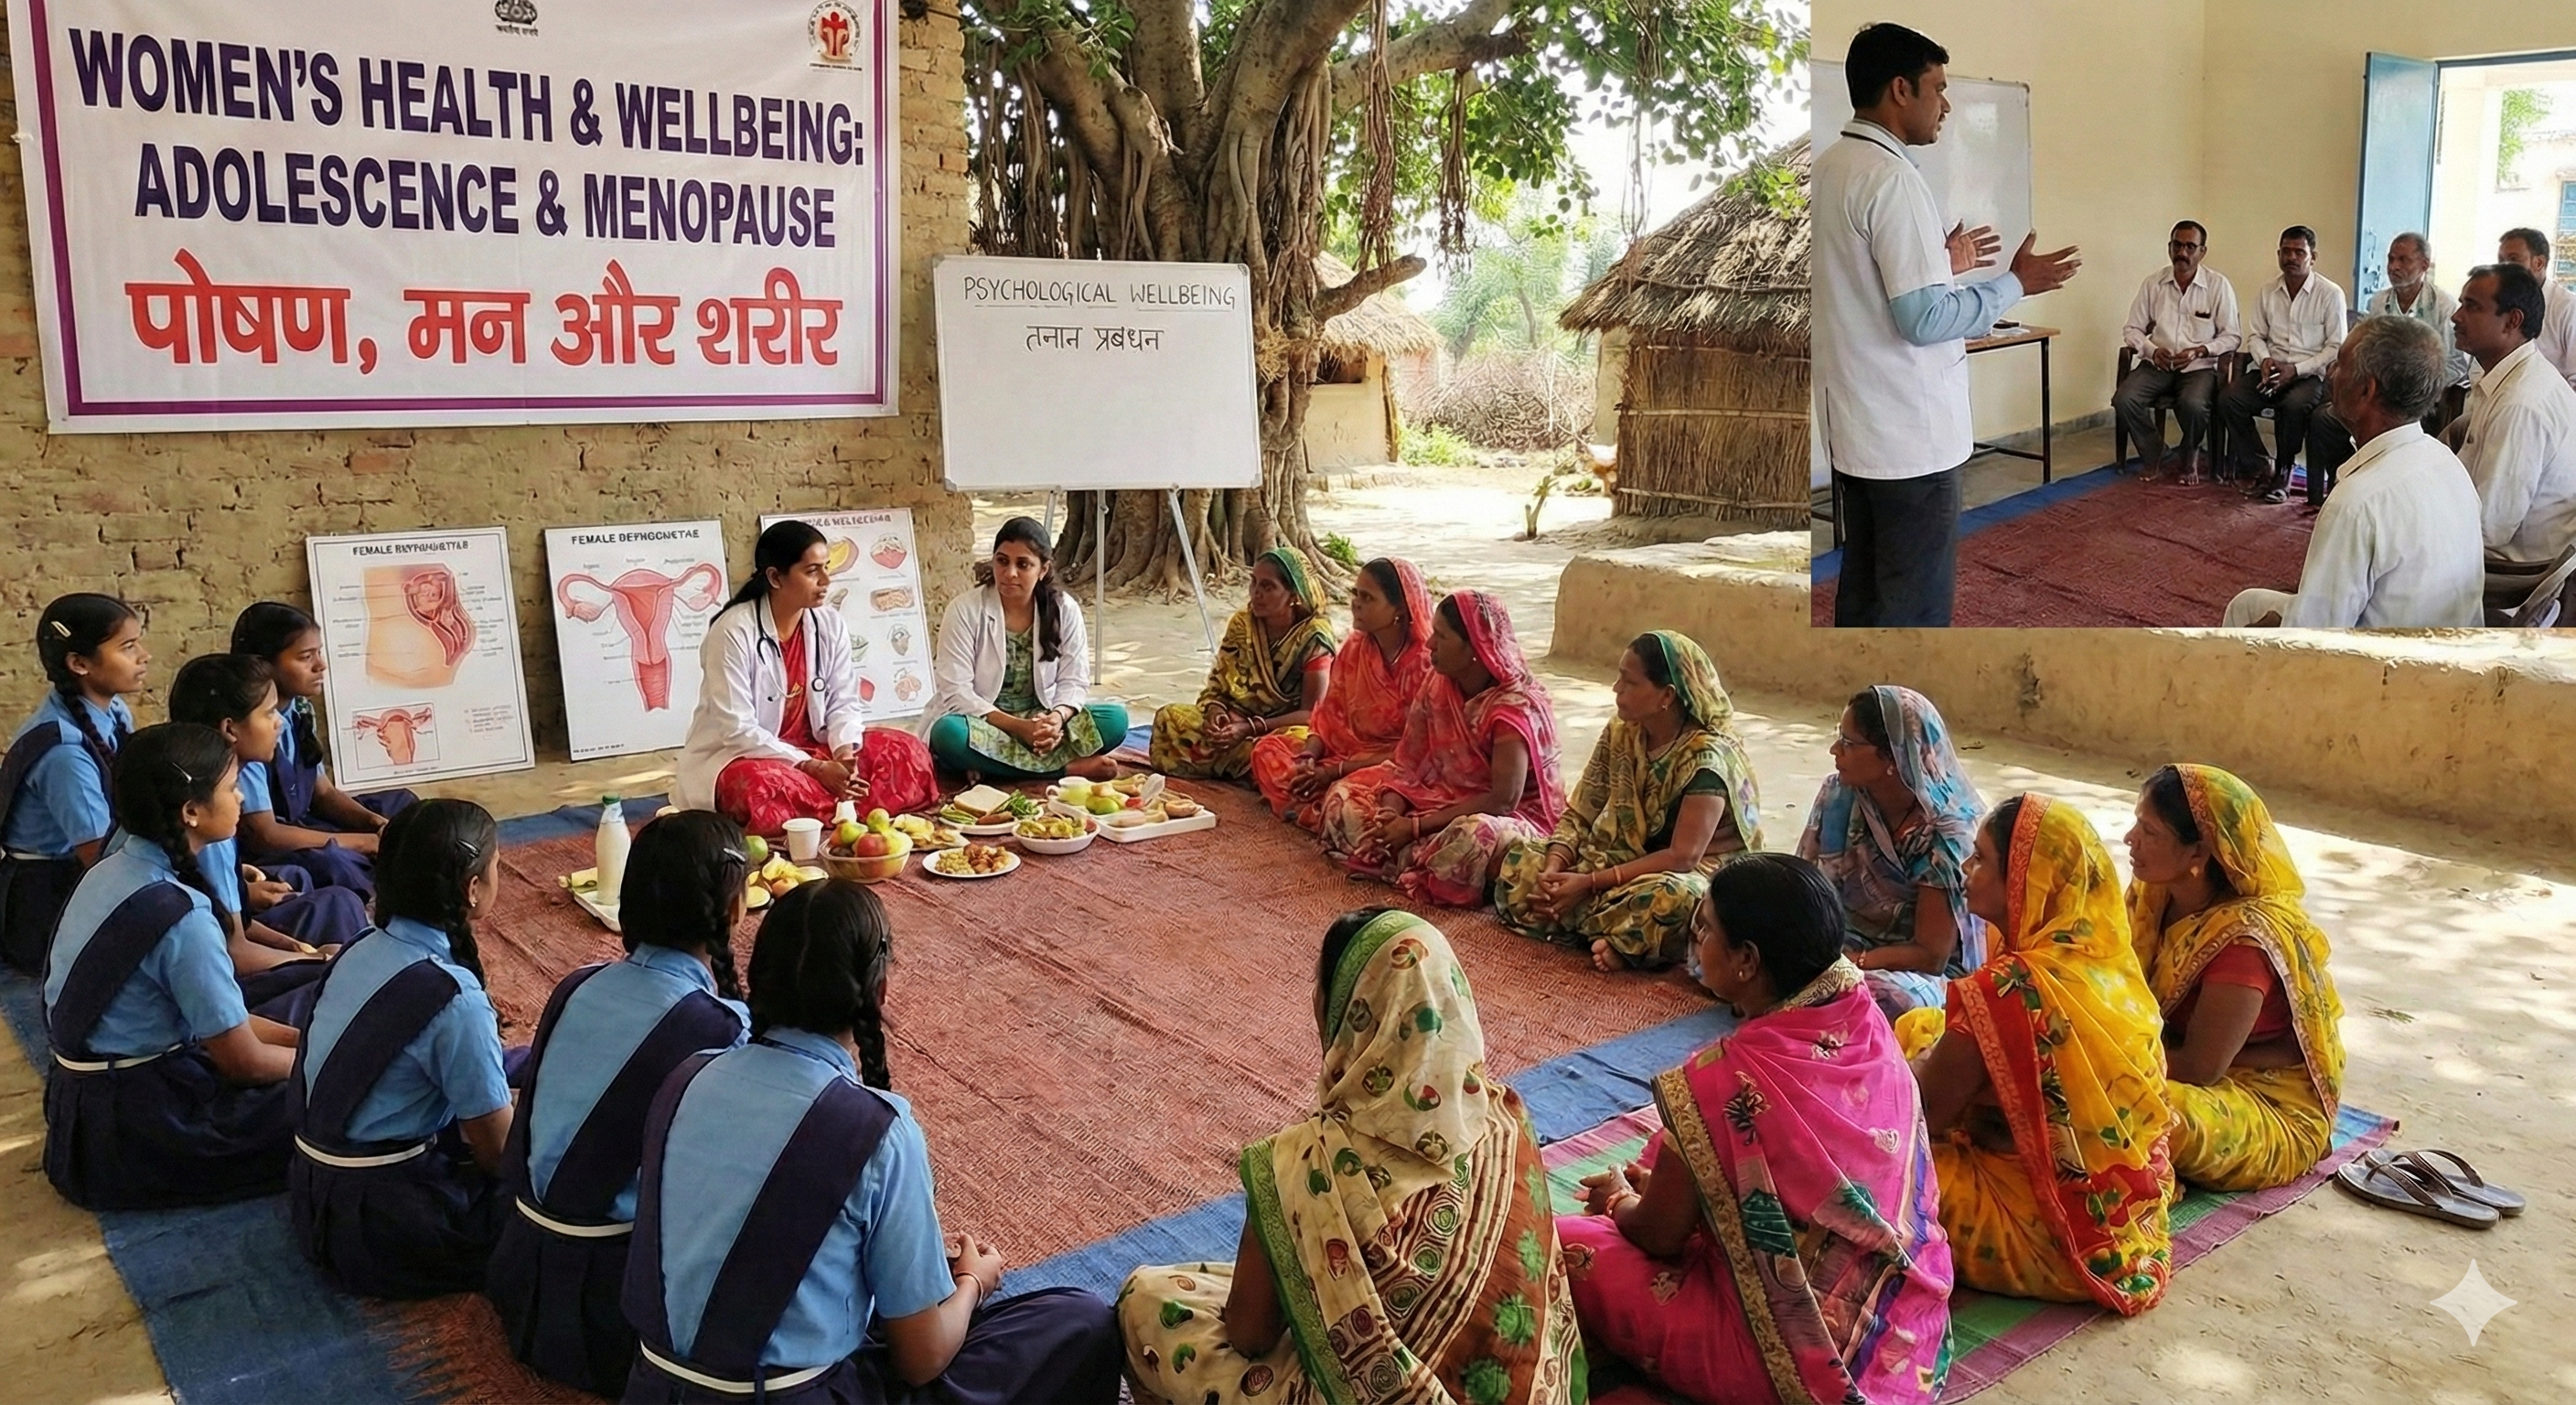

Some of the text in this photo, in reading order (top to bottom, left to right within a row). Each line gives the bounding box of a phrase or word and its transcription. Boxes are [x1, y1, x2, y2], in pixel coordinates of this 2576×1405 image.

[68, 27, 864, 166] WOMEN'S HEALTH & WELLBEING:
[134, 143, 835, 248] ADOLESCENCE & MENOPAUSE
[124, 249, 843, 374] पोषण, मन और शरीर
[963, 276, 1235, 309] PSYCHOLOGICAL WELLBEING
[353, 545, 392, 555] FEMALE
[571, 533, 616, 544] FEMALE
